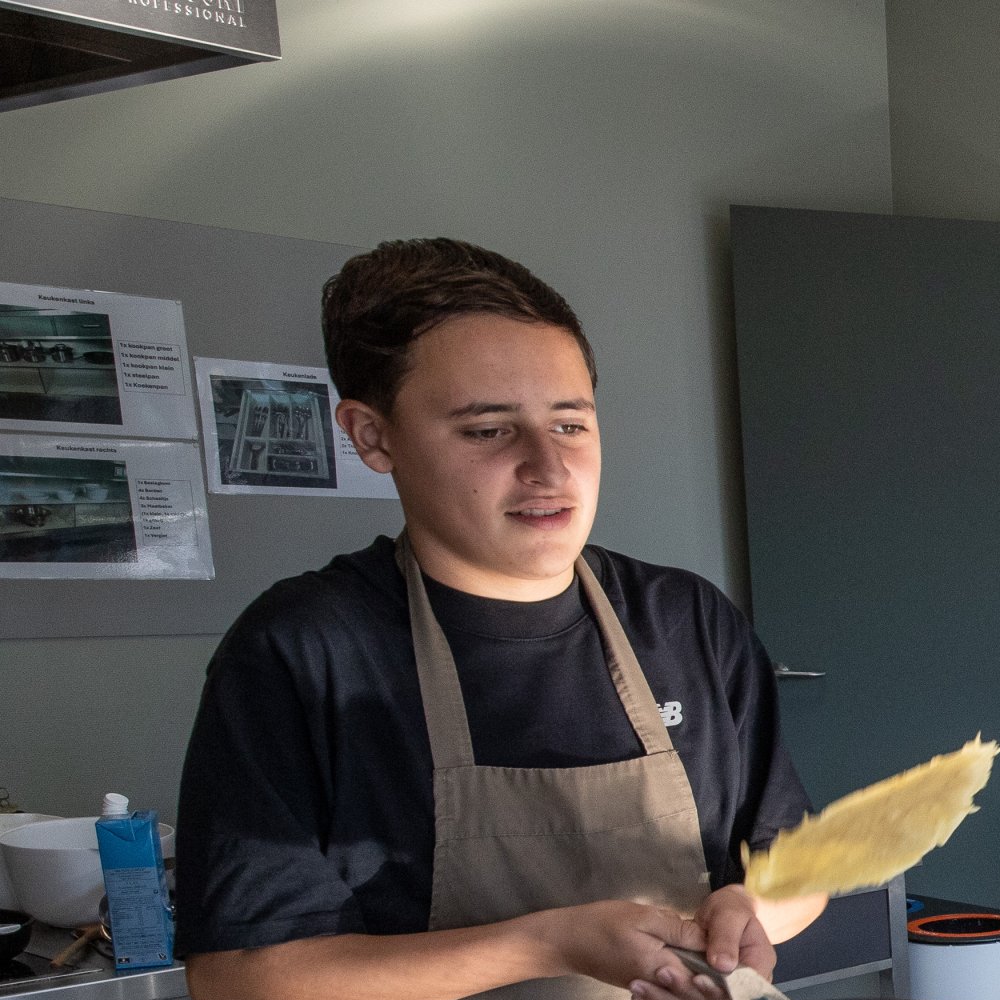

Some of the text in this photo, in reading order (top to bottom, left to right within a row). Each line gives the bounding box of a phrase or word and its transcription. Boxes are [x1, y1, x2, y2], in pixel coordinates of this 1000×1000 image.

[38, 294, 78, 304] Keukenkast
[128, 343, 156, 351] kookpan
[131, 372, 160, 380] steelpan
[282, 371, 318, 380] Keukenlade
[56, 445, 95, 453] Keukenkast
